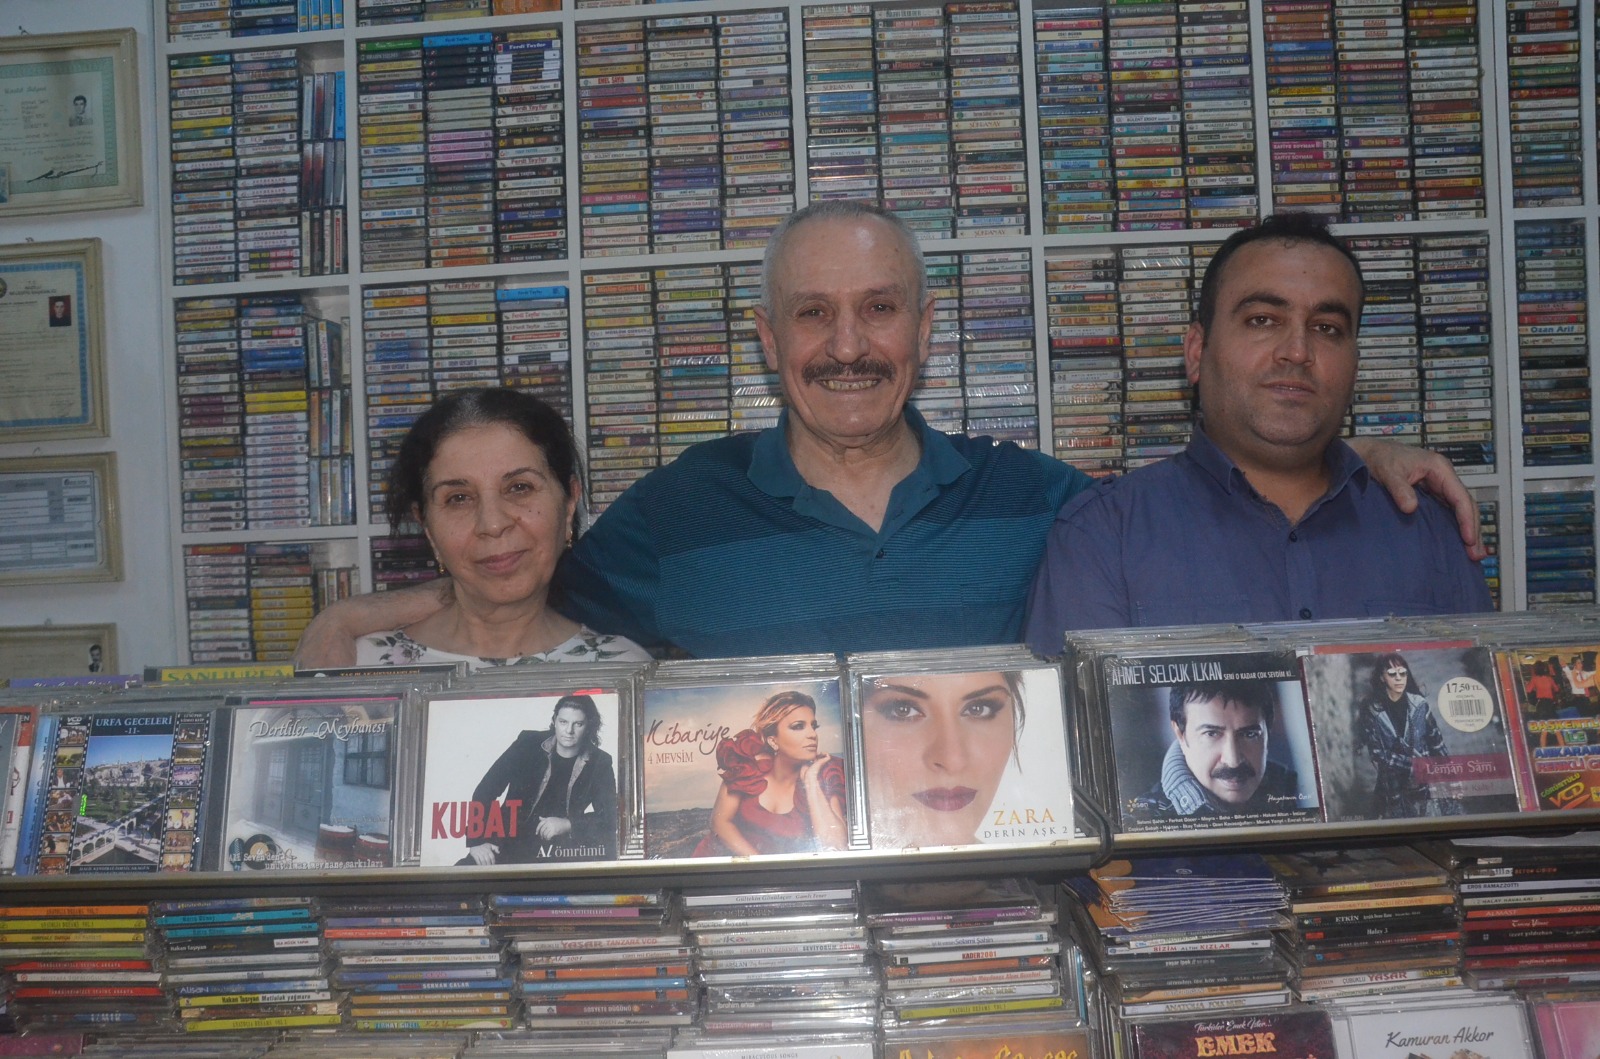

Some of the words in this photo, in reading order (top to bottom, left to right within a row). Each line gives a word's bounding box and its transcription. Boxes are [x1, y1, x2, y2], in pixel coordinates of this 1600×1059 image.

[1556, 325, 1575, 333] Arif
[1112, 665, 1146, 686] AHMET
[1150, 663, 1191, 684] SELÇUK
[1192, 660, 1223, 683] İLKAN
[95, 718, 123, 727] URFA
[124, 716, 173, 727] GECELERİ
[248, 720, 308, 738] Dertliler
[311, 717, 386, 742] Meyhanesi
[646, 719, 732, 756] Kibariye
[647, 755, 653, 764] 4
[655, 750, 694, 765] MEVSİM
[1548, 782, 1585, 808] VCD
[431, 799, 523, 840] KUBAT
[993, 807, 1056, 826] ZARA
[983, 828, 1025, 839] DERİN
[1033, 826, 1058, 838] AŞK
[1062, 826, 1068, 834] 2
[536, 845, 554, 859] Al
[554, 845, 607, 858] ömrümü
[1165, 1002, 1204, 1012] ANATOLIA
[1194, 1031, 1278, 1058] EMEK
[1385, 1031, 1450, 1049] Kamuran
[1452, 1026, 1495, 1043] Akkor
